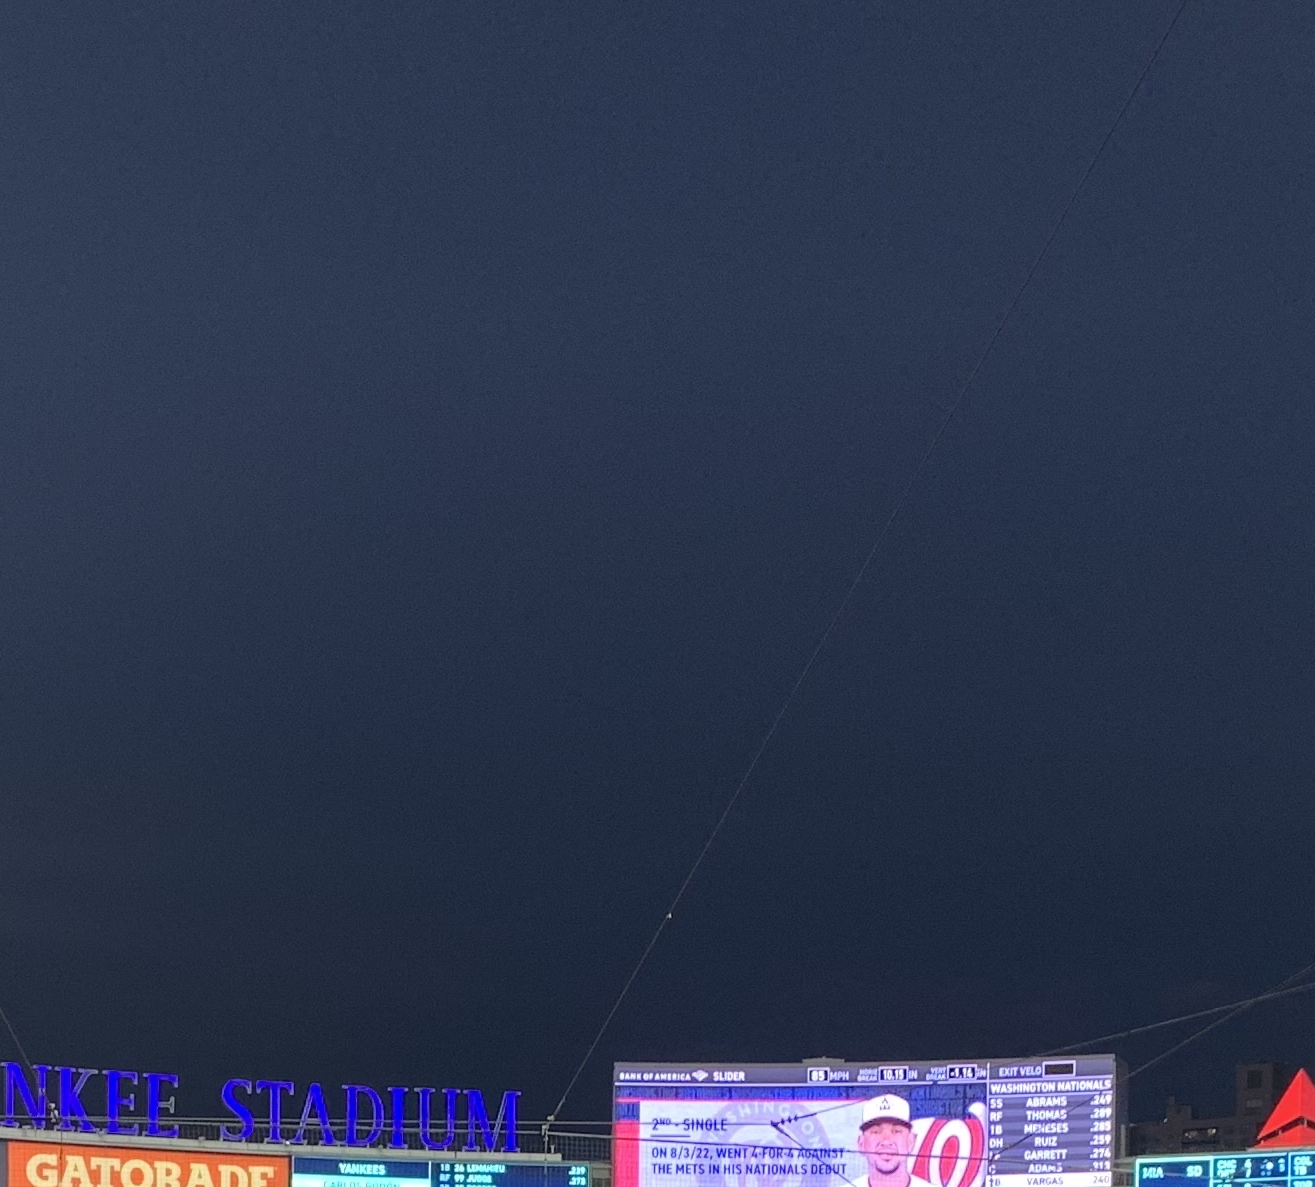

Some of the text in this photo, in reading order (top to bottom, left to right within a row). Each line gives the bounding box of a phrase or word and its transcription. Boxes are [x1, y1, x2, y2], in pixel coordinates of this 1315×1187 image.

[713, 1071, 746, 1082] SLIDER
[999, 1066, 1042, 1077] EXIT VELO
[990, 1080, 1111, 1093] WASHINGTON NATIONALS
[990, 1099, 1003, 1108] SS
[1026, 1096, 1067, 1107] ABRAMS
[220, 1078, 522, 1152] STADIUM
[990, 1112, 1002, 1121] RF
[1026, 1110, 1067, 1120] THOMAS
[683, 1119, 728, 1132] SINGLE
[990, 1125, 1003, 1134] 1B
[1024, 1123, 1068, 1134] MENESES
[990, 1138, 1003, 1148] DH
[1035, 1136, 1057, 1147] RUIZ
[651, 1147, 844, 1160] ON 8/3/22, WENT 4-FOR-4 AGAINST
[1024, 1149, 1067, 1160] GARRETT
[339, 1163, 386, 1175] YANKEES
[651, 1163, 847, 1175] THE METS IN HIS NATIONALS DEBUT
[1028, 1163, 1063, 1173] ADAMS
